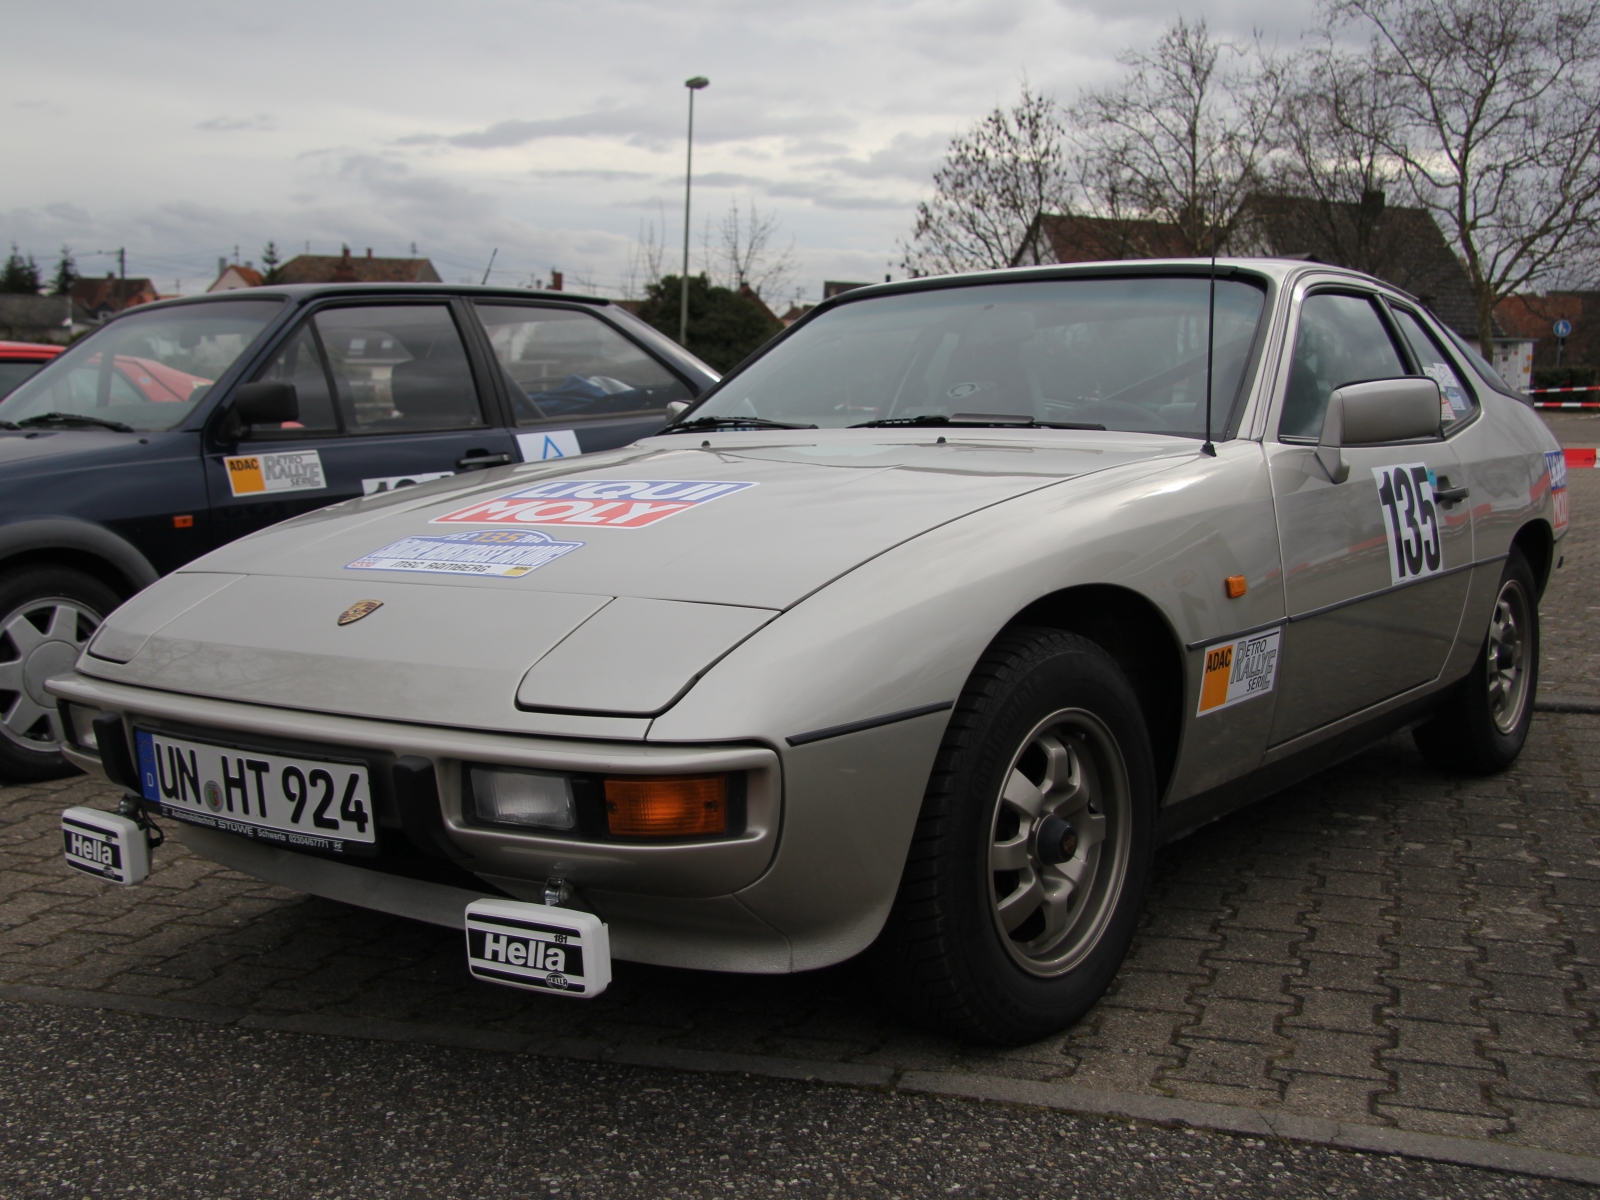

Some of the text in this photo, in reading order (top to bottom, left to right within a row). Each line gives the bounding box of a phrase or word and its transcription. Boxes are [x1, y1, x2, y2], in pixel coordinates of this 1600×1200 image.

[229, 459, 259, 472] ADAC
[512, 482, 739, 501] LIQUI
[449, 501, 690, 524] MOLY
[1379, 465, 1441, 578] 135
[472, 531, 527, 543] 135
[389, 560, 425, 568] MSC
[422, 562, 492, 573] RAMBERG
[1205, 647, 1232, 674] ADAC
[147, 772, 154, 788] D
[154, 742, 370, 834] UN HT 924
[71, 833, 113, 866] Hella
[553, 933, 568, 945] 181
[484, 932, 566, 972] Hella
